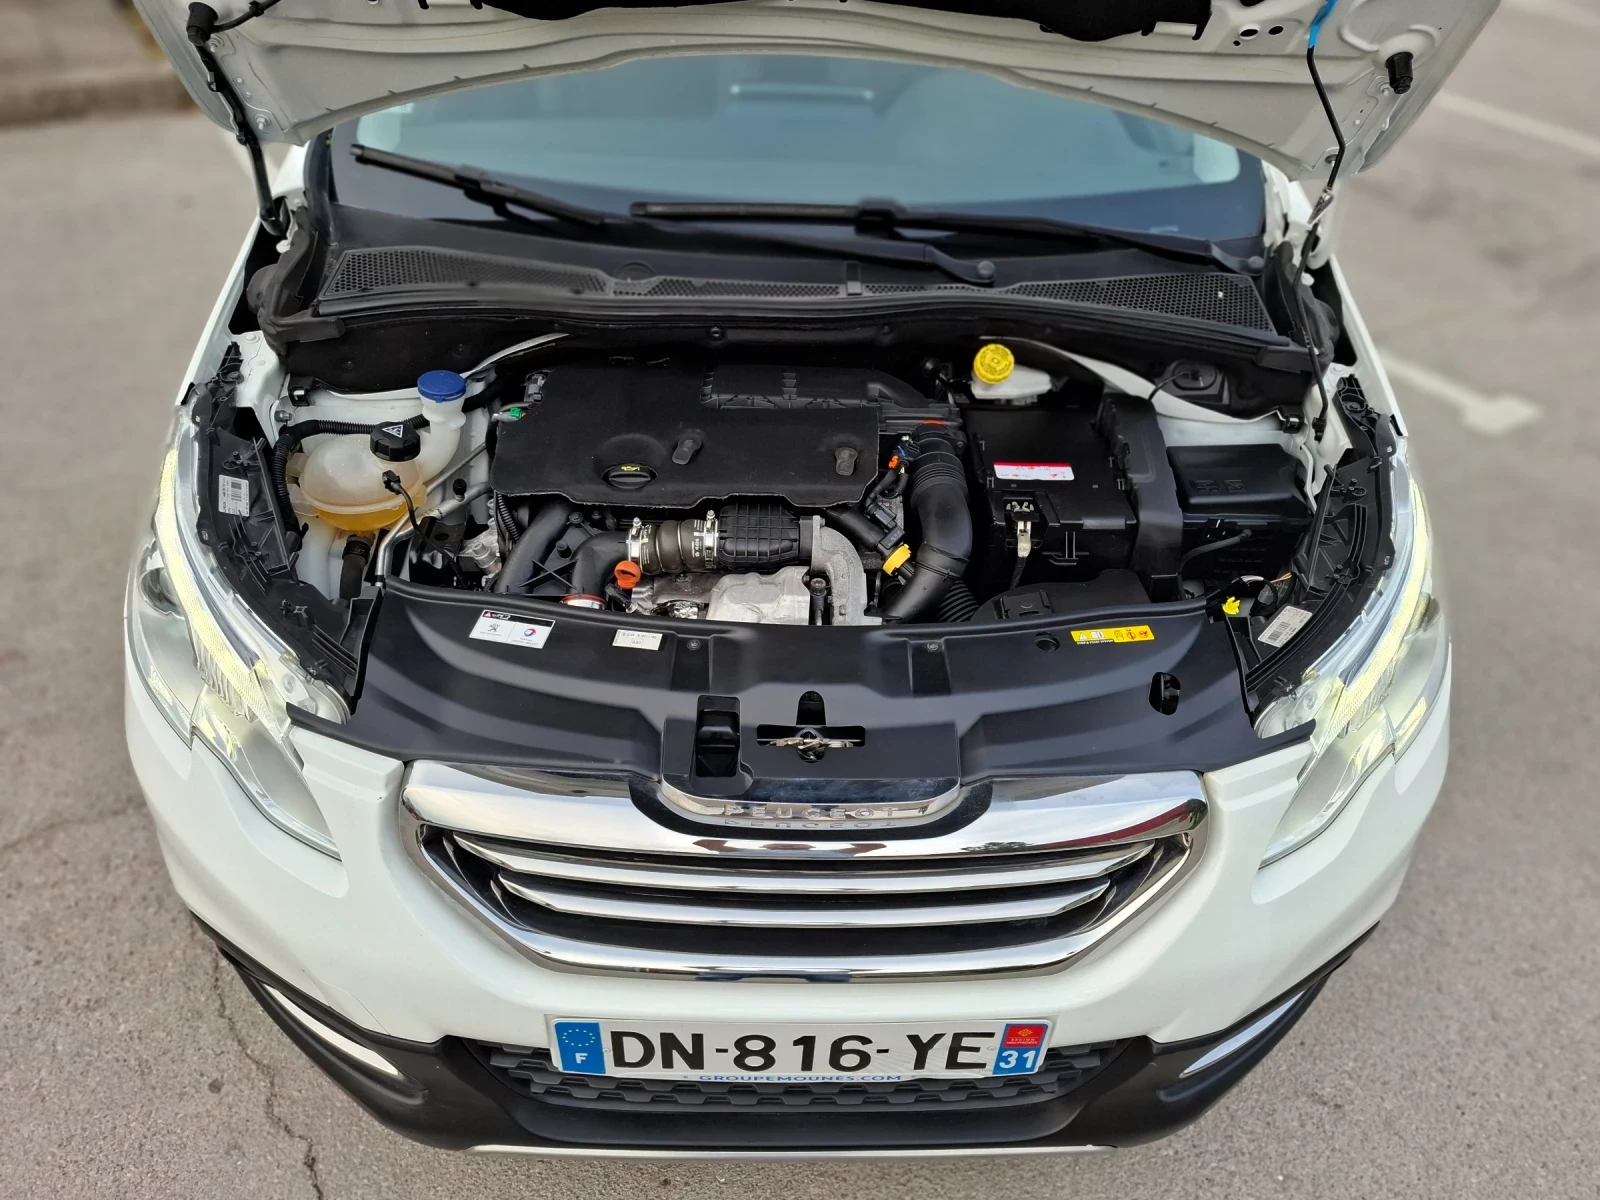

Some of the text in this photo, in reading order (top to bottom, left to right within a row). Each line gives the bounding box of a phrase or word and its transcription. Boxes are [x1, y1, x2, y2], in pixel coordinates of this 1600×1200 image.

[723, 803, 899, 819] PEUGEOT
[575, 1052, 588, 1064] F
[999, 1050, 1036, 1069] 31
